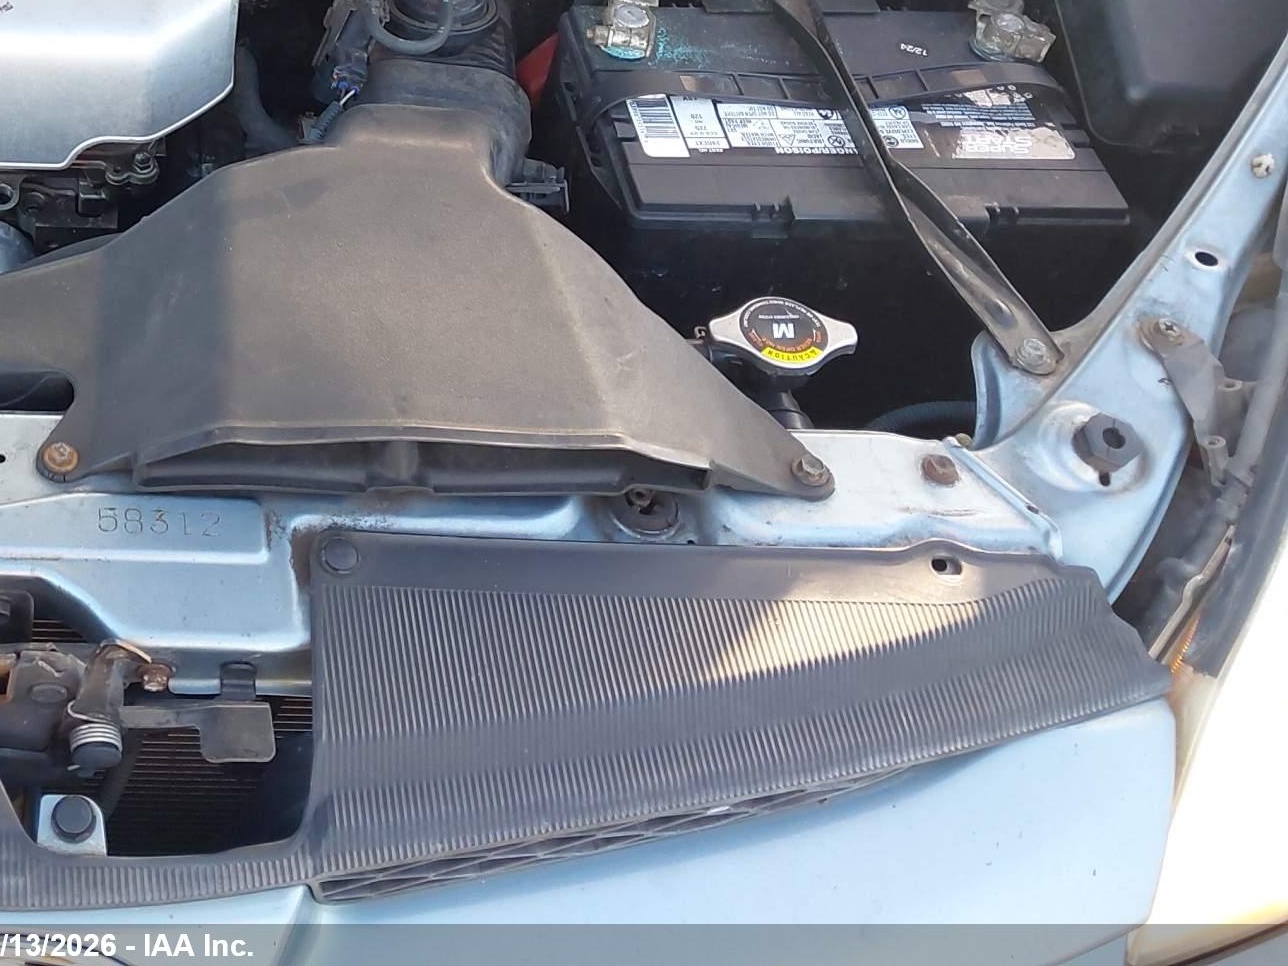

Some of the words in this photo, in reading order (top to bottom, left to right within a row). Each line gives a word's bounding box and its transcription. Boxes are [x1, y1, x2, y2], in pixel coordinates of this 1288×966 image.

[900, 43, 928, 57] 12/24
[966, 144, 1031, 154] SUPER
[772, 323, 795, 339] M
[767, 350, 811, 361] CAUTION
[98, 506, 222, 537] 58312
